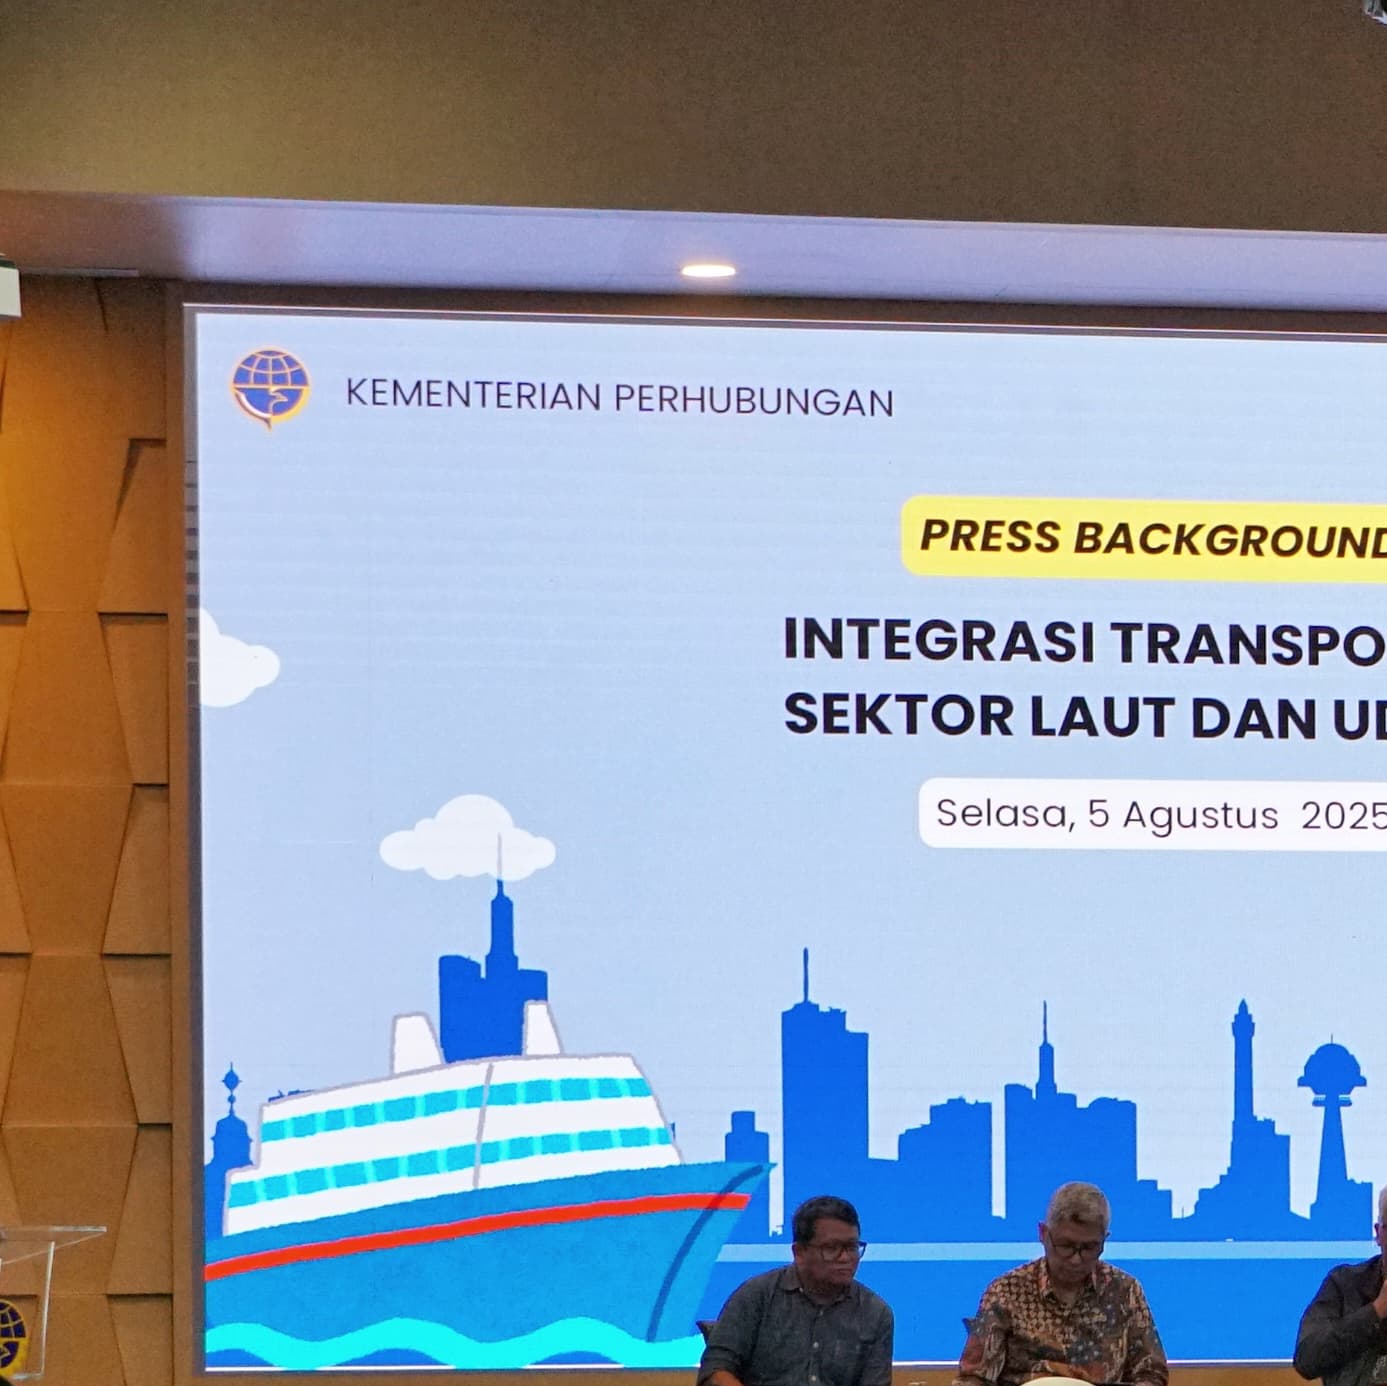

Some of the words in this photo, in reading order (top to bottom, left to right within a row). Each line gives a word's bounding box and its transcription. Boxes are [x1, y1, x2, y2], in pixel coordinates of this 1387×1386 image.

[347, 377, 601, 411] KEMENTERIAN
[615, 383, 893, 417] PERHUBUNGAN
[920, 518, 1061, 554] PRESS
[785, 616, 1094, 663] INTEGRASI
[784, 691, 1014, 736] SEKTOR
[1031, 695, 1176, 738] LAUT
[1192, 697, 1316, 740] DAN
[937, 797, 1075, 833] Selasa,
[1089, 799, 1110, 828] 5
[1123, 800, 1279, 839] Agustus
